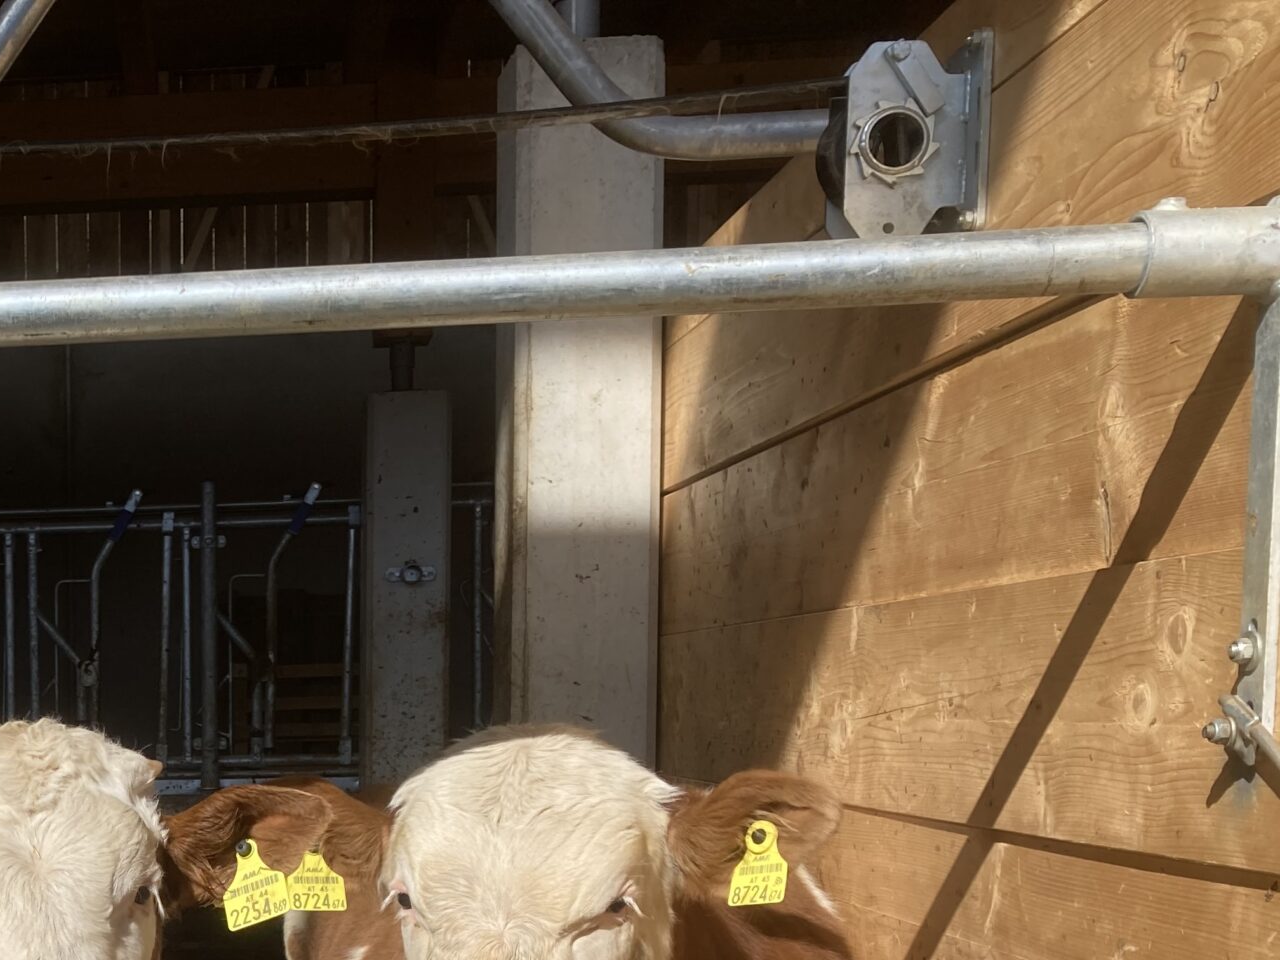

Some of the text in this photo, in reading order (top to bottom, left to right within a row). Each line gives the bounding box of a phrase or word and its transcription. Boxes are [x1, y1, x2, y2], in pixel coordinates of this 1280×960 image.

[293, 893, 345, 910] 8724 674
[731, 884, 768, 904] 8724
[230, 897, 287, 929] 2254 869
